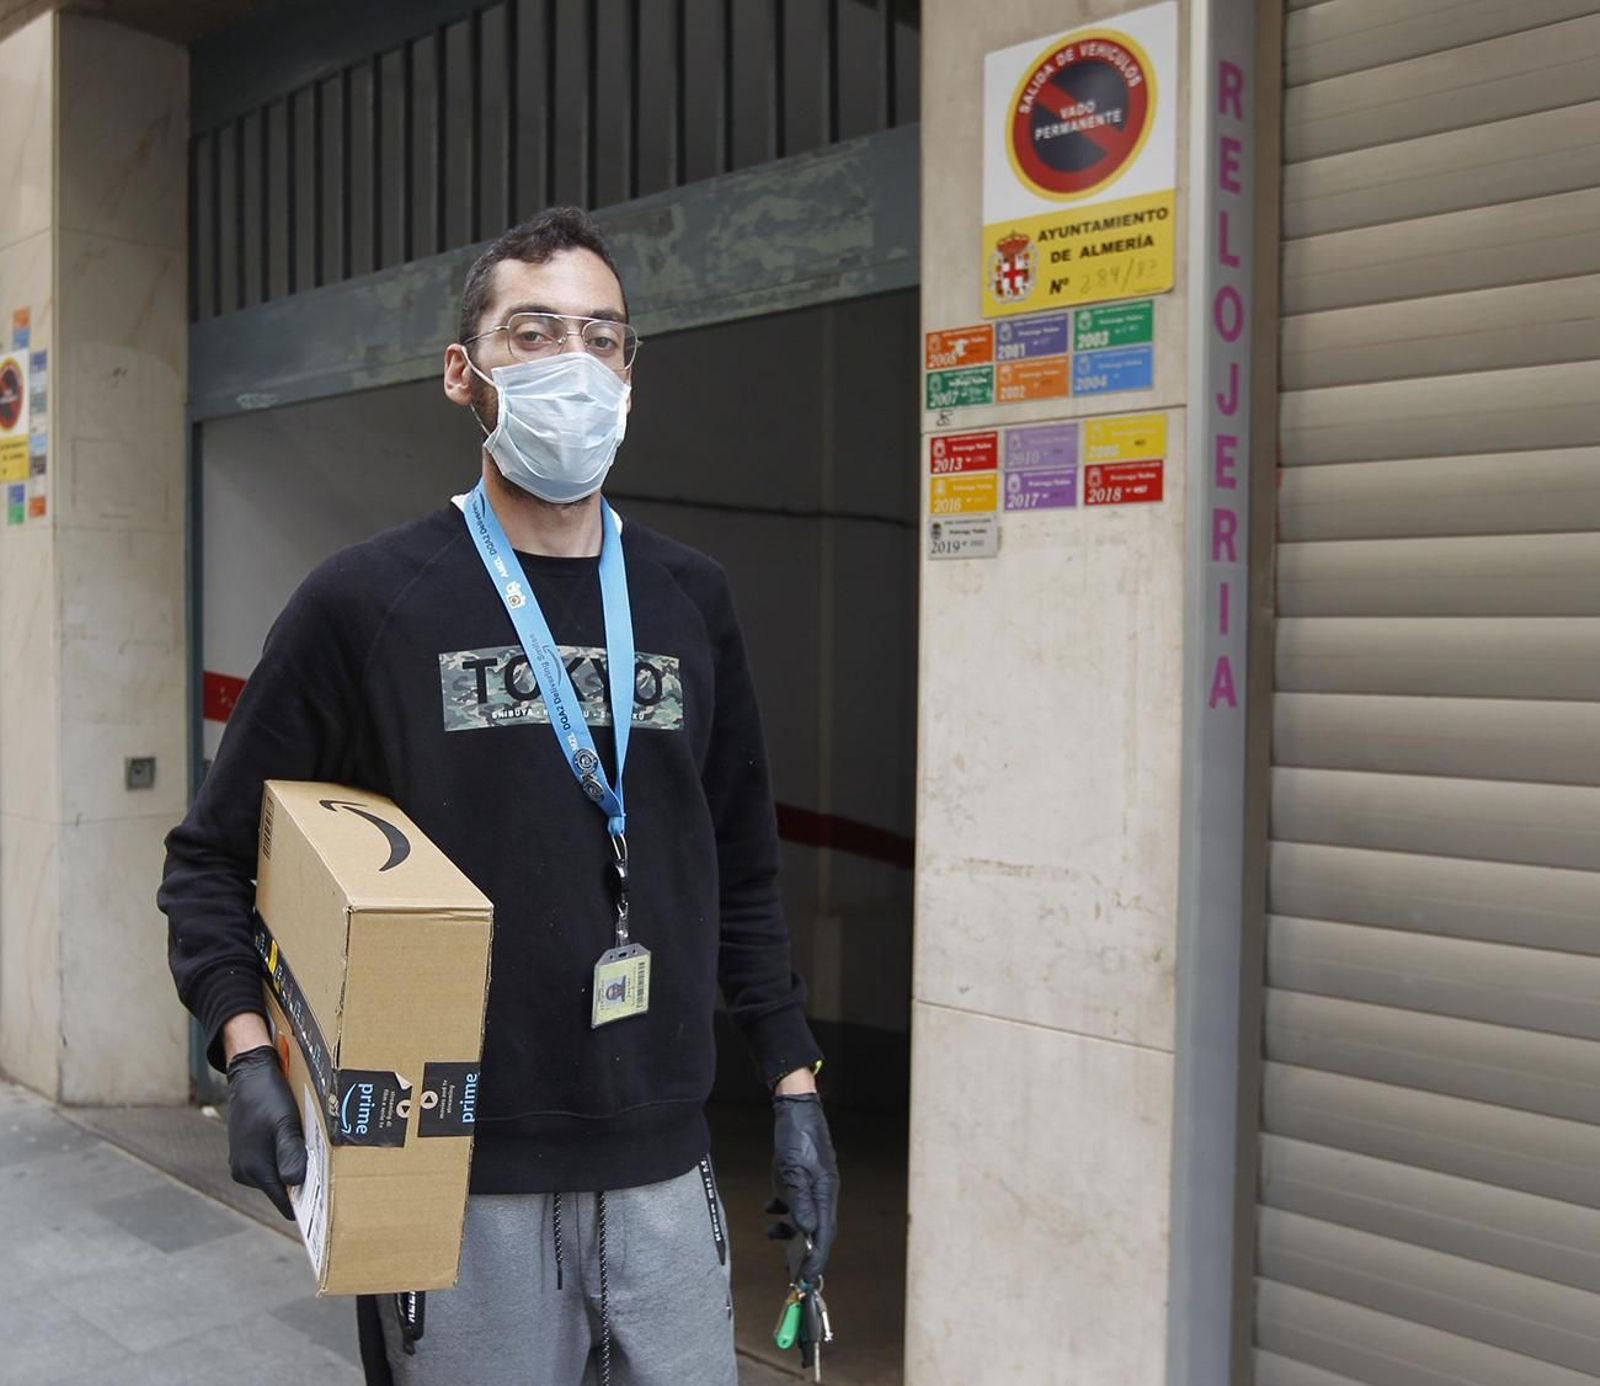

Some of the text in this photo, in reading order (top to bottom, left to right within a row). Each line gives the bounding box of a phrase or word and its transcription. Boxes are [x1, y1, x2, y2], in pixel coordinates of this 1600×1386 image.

[1019, 43, 1143, 114] SALIDA DE VEHICULOS
[1059, 100, 1096, 119] VADO
[1034, 108, 1123, 141] PERMANENTE
[1037, 207, 1169, 242] AYUNTAMIENTO
[1051, 234, 1154, 264] DE ALMERÍA
[1208, 59, 1244, 709] RELOJERIA
[930, 388, 959, 408] 2007
[933, 456, 963, 473] 2013
[934, 497, 962, 512] 2016
[1007, 493, 1040, 509] 2017
[1088, 486, 1123, 503] 2018
[930, 540, 961, 555] 2019
[540, 661, 562, 705] Delivering
[491, 707, 533, 720] SHIBUYA
[555, 704, 572, 731] DQA2
[355, 1082, 375, 1135] prime
[459, 1072, 479, 1124] prime
